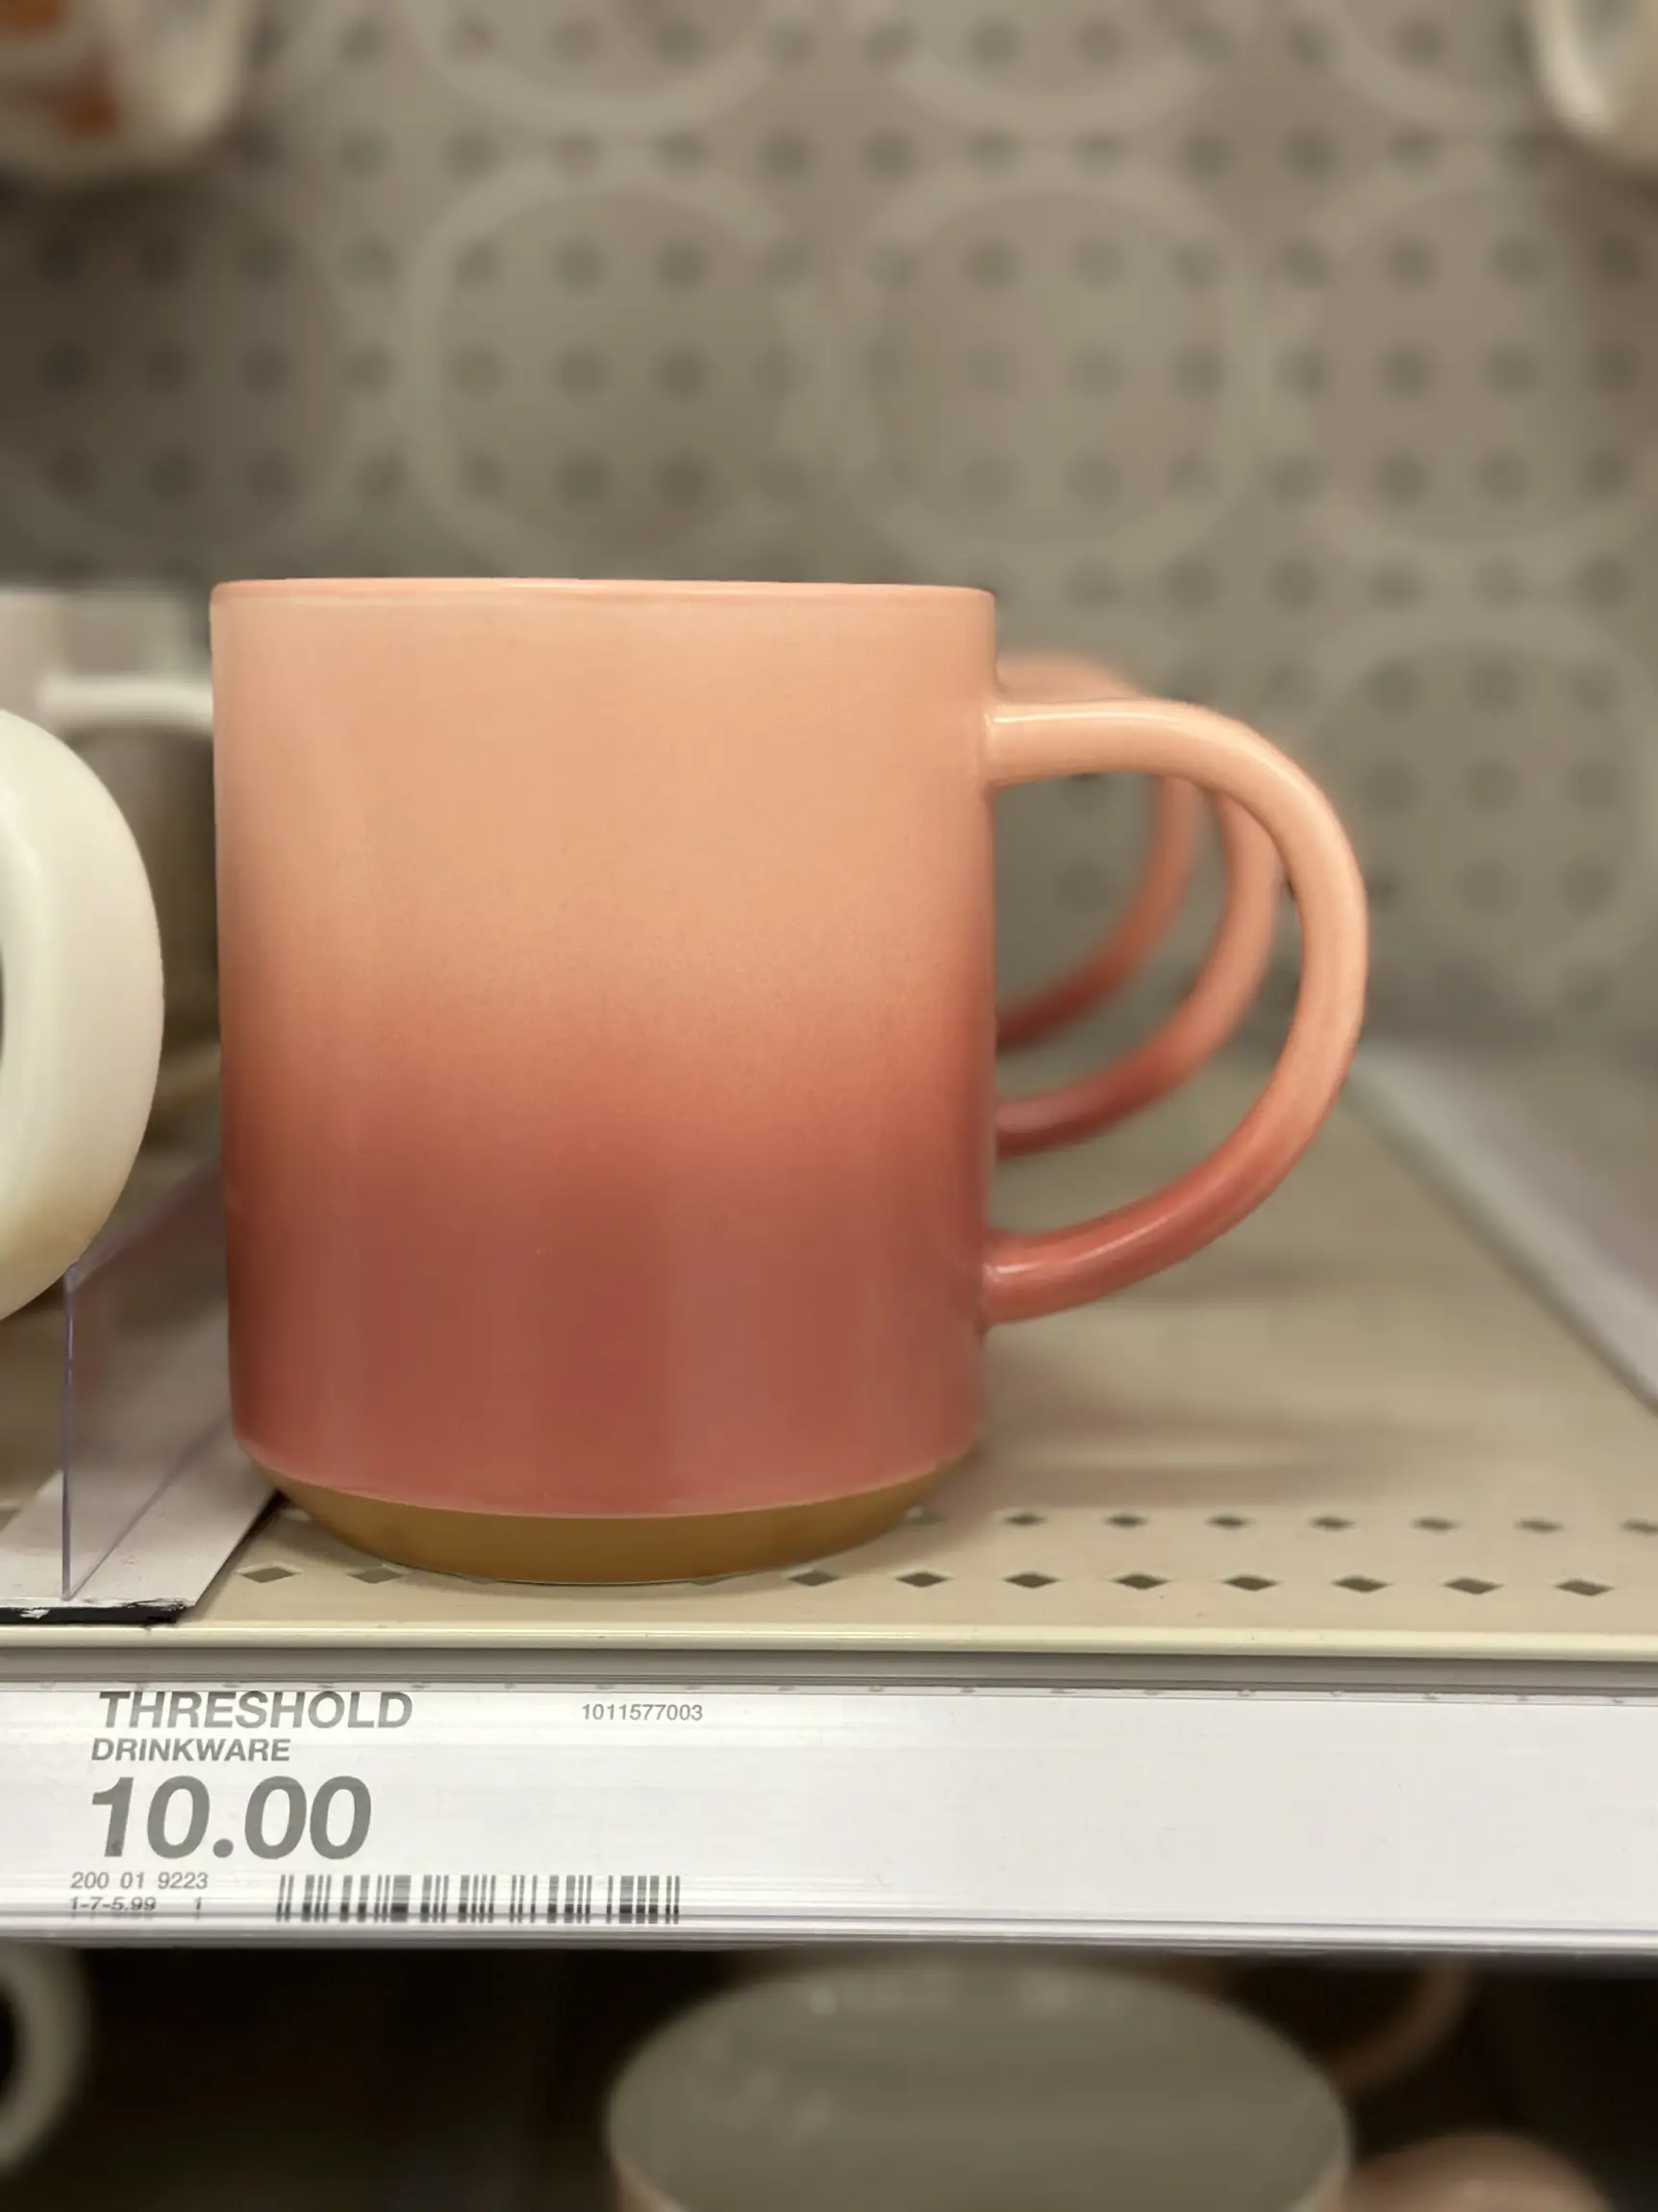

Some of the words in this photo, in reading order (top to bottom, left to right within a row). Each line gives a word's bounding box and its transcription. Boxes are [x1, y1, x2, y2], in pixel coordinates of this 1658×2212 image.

[98, 1690, 414, 1729] THRESHOLD
[582, 1703, 703, 1721] 1011577003
[90, 1738, 291, 1762] DRINKWARE
[91, 1775, 372, 1860] 10.00
[70, 1872, 110, 1890] 200
[119, 1872, 144, 1890] 01
[157, 1872, 209, 1890] 9223
